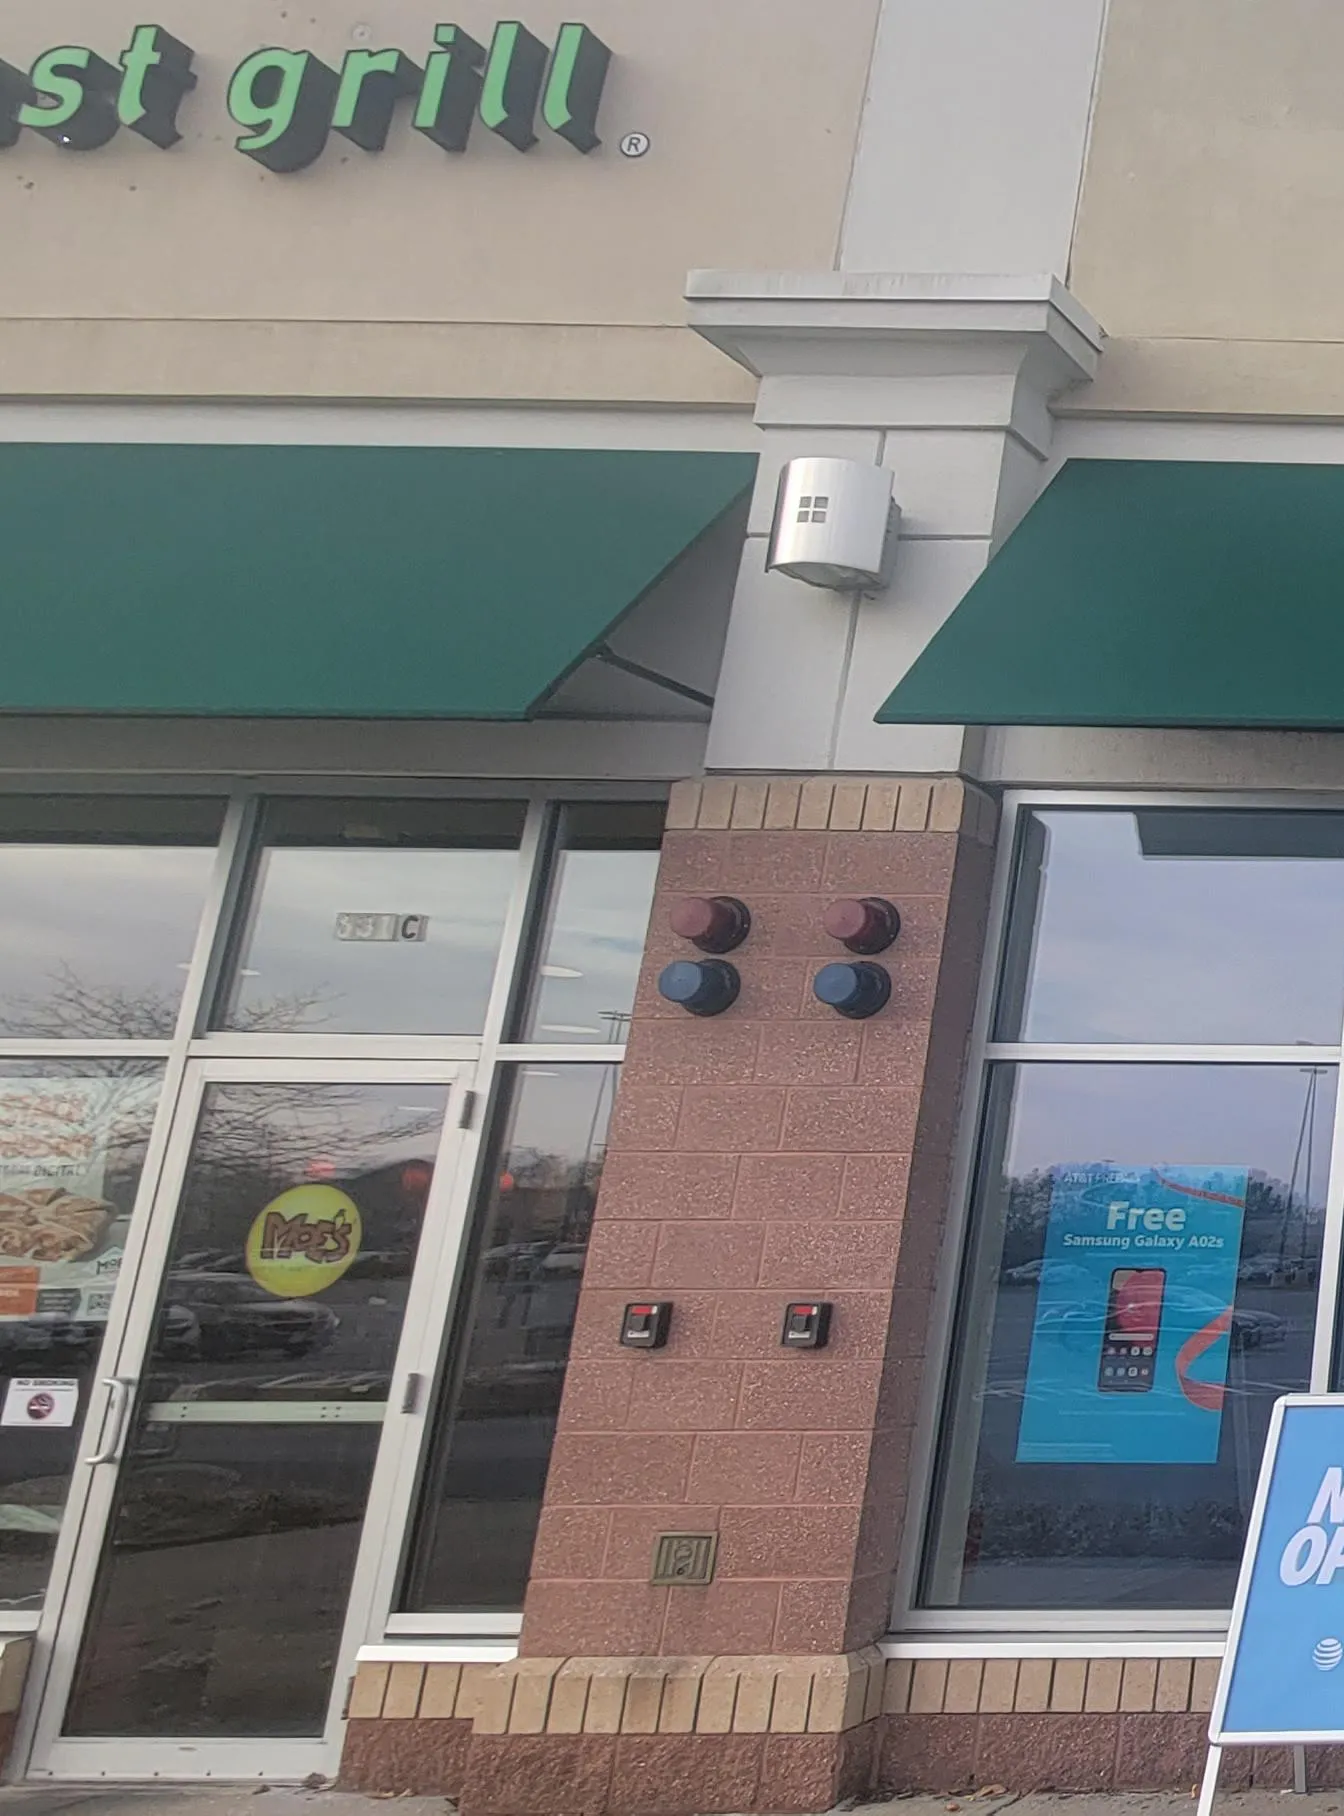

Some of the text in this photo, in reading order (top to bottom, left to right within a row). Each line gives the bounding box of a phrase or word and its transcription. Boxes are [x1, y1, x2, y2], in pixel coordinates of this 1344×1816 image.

[227, 20, 602, 162] grill
[1107, 1201, 1187, 1231] Free
[1063, 1234, 1224, 1250] Samsung Galaxy A02s
